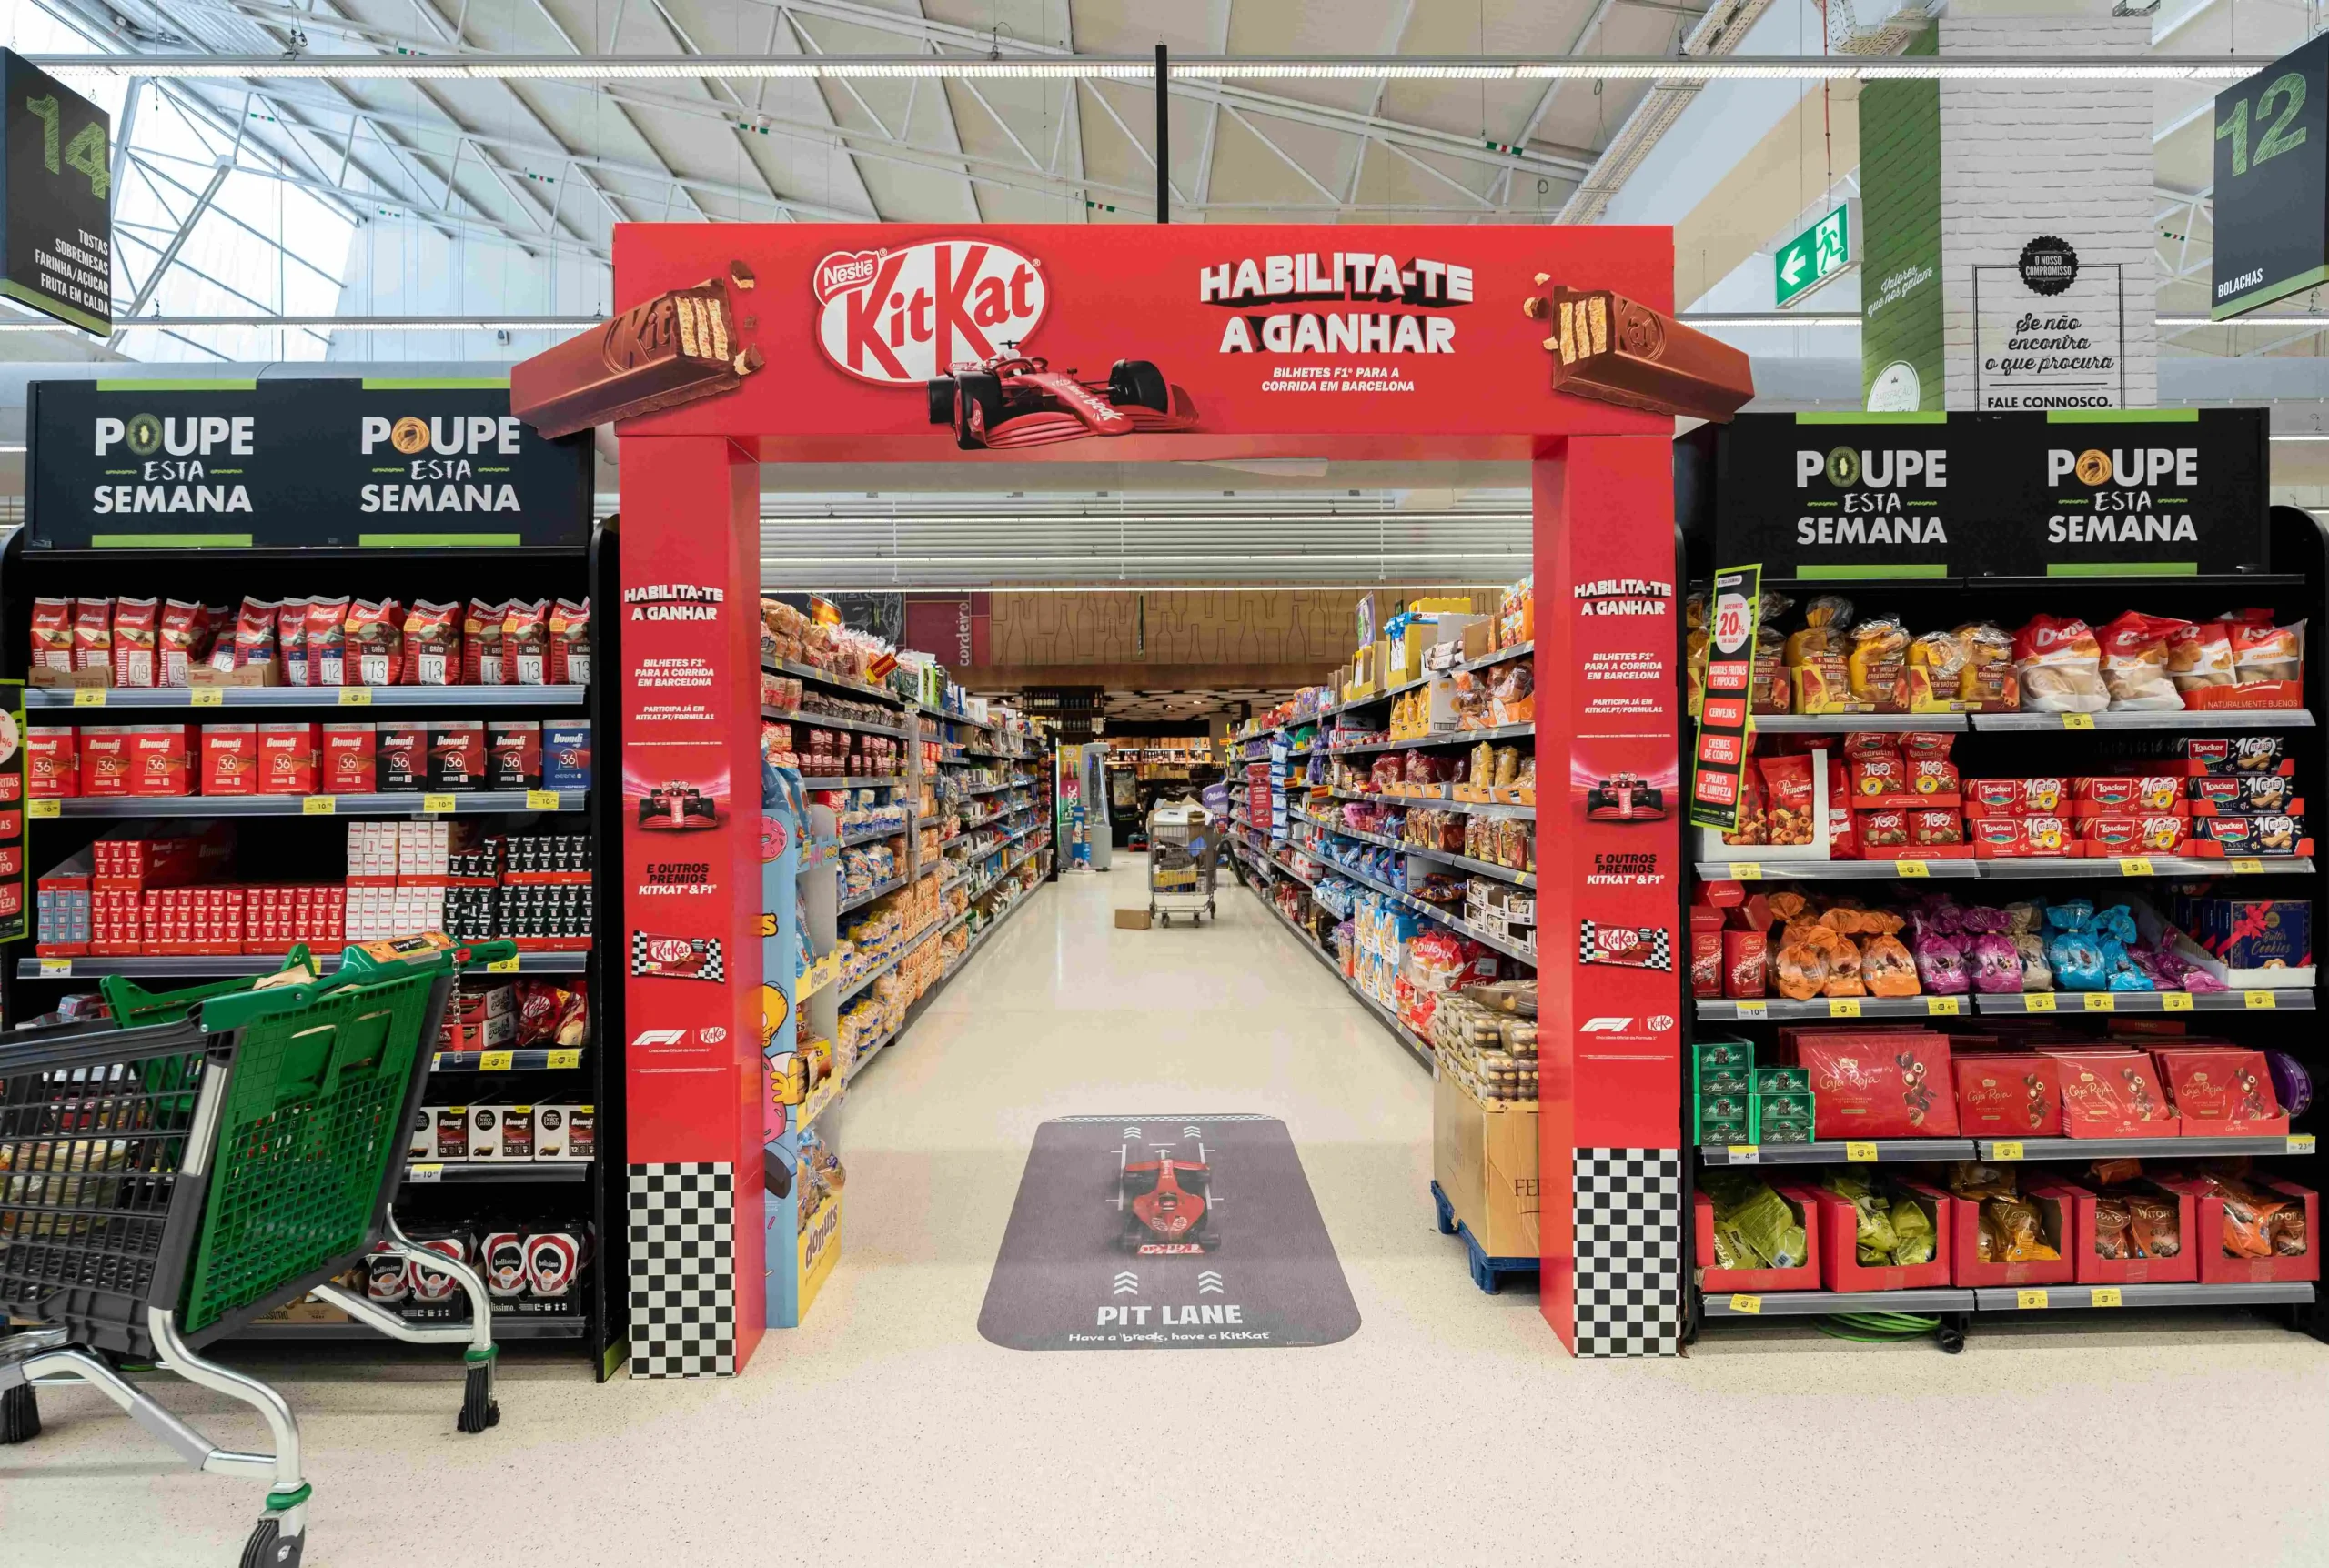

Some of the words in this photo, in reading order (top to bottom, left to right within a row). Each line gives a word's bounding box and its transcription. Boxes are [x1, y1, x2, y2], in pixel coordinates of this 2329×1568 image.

[2216, 73, 2306, 176] 12
[27, 94, 111, 200] 14
[78, 229, 108, 256] TOSTAS
[55, 238, 108, 276] SOBREMESAS
[2034, 256, 2039, 265] O
[2041, 256, 2062, 265] NOSSO
[35, 249, 109, 296] FARINHA/AÇÚCAR
[2025, 266, 2072, 276] COMPROMISSO
[1200, 252, 1473, 306] HABILITA-TE
[1880, 265, 1918, 294] Valores
[2218, 268, 2263, 297] BOLACHAS
[41, 273, 67, 297] FRUTA
[69, 286, 81, 304] EM
[83, 293, 109, 316] CALDA
[1867, 296, 1884, 318] que
[1884, 288, 1901, 305] nos
[1901, 266, 1933, 298] guiam
[847, 245, 1034, 379] KitKat
[2016, 313, 2042, 335] Se
[2043, 317, 2082, 330] não
[1219, 317, 1248, 354] A
[1263, 312, 1456, 354] GANHAR
[2008, 334, 2091, 350] encontra
[1273, 367, 1331, 378] BILHETES
[1356, 367, 1388, 378] PARA
[1390, 367, 1399, 377] A
[1985, 356, 1998, 370] o
[2001, 356, 2037, 376] que
[2037, 356, 2114, 374] procura
[1261, 380, 1316, 392] CORRIDA
[1319, 380, 1338, 391] EM
[1341, 380, 1415, 392] BARCELONA
[1988, 397, 2019, 408] FALE
[2022, 396, 2113, 408] CONNOSCO.
[95, 413, 255, 457] POUPE
[361, 417, 521, 455] POUPE
[143, 460, 205, 482] ESTA
[410, 459, 471, 481] ESTA
[1796, 446, 1947, 487] POUPE
[2048, 448, 2198, 487] POUPE
[93, 485, 254, 514] SEMANA
[360, 484, 521, 512] SEMANA
[1843, 492, 1901, 514] ESTA
[2094, 491, 2152, 512] ESTA
[1796, 516, 1948, 545] SEMANA
[2047, 515, 2198, 543] SEMANA
[624, 584, 723, 603] HABILITA-TE
[1574, 579, 1672, 598] HABILITA-TE
[631, 608, 644, 620] A
[646, 606, 717, 620] GANHAR
[1581, 602, 1594, 616] A
[1596, 600, 1666, 615] GANHAR
[1719, 611, 1745, 636] 20%
[956, 602, 970, 666] cordeiro
[643, 658, 689, 667] BILHETES
[1592, 653, 1637, 661] BILHETES
[117, 646, 128, 687] ORIGINAL
[134, 665, 148, 680] 09
[328, 663, 340, 678] 12
[427, 660, 443, 679] 13
[635, 668, 660, 677] PARA
[662, 668, 670, 677] A
[671, 668, 714, 677] CORRIDA
[1584, 662, 1609, 670] PARA
[1611, 662, 1618, 670] A
[1620, 662, 1663, 670] CORRIDA
[1729, 665, 1747, 676] FRITAS
[638, 678, 653, 687] EM
[655, 678, 711, 687] BARCELONA
[1587, 672, 1602, 680] EM
[1717, 676, 1739, 687] PIPOCAS
[682, 704, 691, 712] JÁ
[2207, 699, 2267, 709] NATURALMENTE
[2268, 699, 2298, 708] BUENOS
[1709, 707, 1737, 719] CERVEJAS
[139, 739, 171, 749] Buondi
[267, 738, 297, 747] Buondi
[437, 735, 469, 746] Buondi
[553, 733, 583, 743] Buondi
[1709, 739, 1731, 749] CREMES
[2193, 743, 2224, 752] Loacker
[2251, 742, 2270, 750] YEARS
[447, 757, 462, 767] 36
[560, 755, 575, 765] 36
[1704, 749, 1711, 759] DE
[1712, 750, 1733, 761] CORPO
[148, 759, 165, 770] 36
[276, 759, 291, 769] 36
[0, 777, 19, 788] RITAS
[1705, 773, 1727, 785] SPRAYS
[1699, 782, 1706, 793] DE
[1707, 784, 1732, 797] LIMPEZA
[1777, 779, 1812, 796] Princesa
[1982, 785, 2011, 793] Loacker
[2037, 783, 2056, 791] YEARS
[1982, 824, 2012, 832] Loacker
[2100, 824, 2131, 832] Loacker
[2213, 821, 2244, 830] Loacker
[1595, 854, 1603, 863] E
[1606, 853, 1657, 863] OUTROS
[646, 864, 655, 873] E
[658, 863, 710, 874] OUTROS
[1603, 930, 1637, 950] KitKat
[656, 940, 689, 960] KitKat
[2251, 940, 2291, 956] Cookies
[1729, 1081, 1746, 1091] Eight
[1820, 1073, 1844, 1092] Caja
[1849, 1072, 1881, 1091] Roja
[2069, 1084, 2088, 1098] Caja
[2089, 1083, 2113, 1097] Roja
[505, 1117, 528, 1125] Buondi
[1729, 1132, 1746, 1141] Eight
[1722, 1229, 1742, 1259] GOLDEN
[1097, 1306, 1152, 1325] PIT
[1162, 1304, 1243, 1325] LANE
[1172, 1332, 1204, 1341] have
